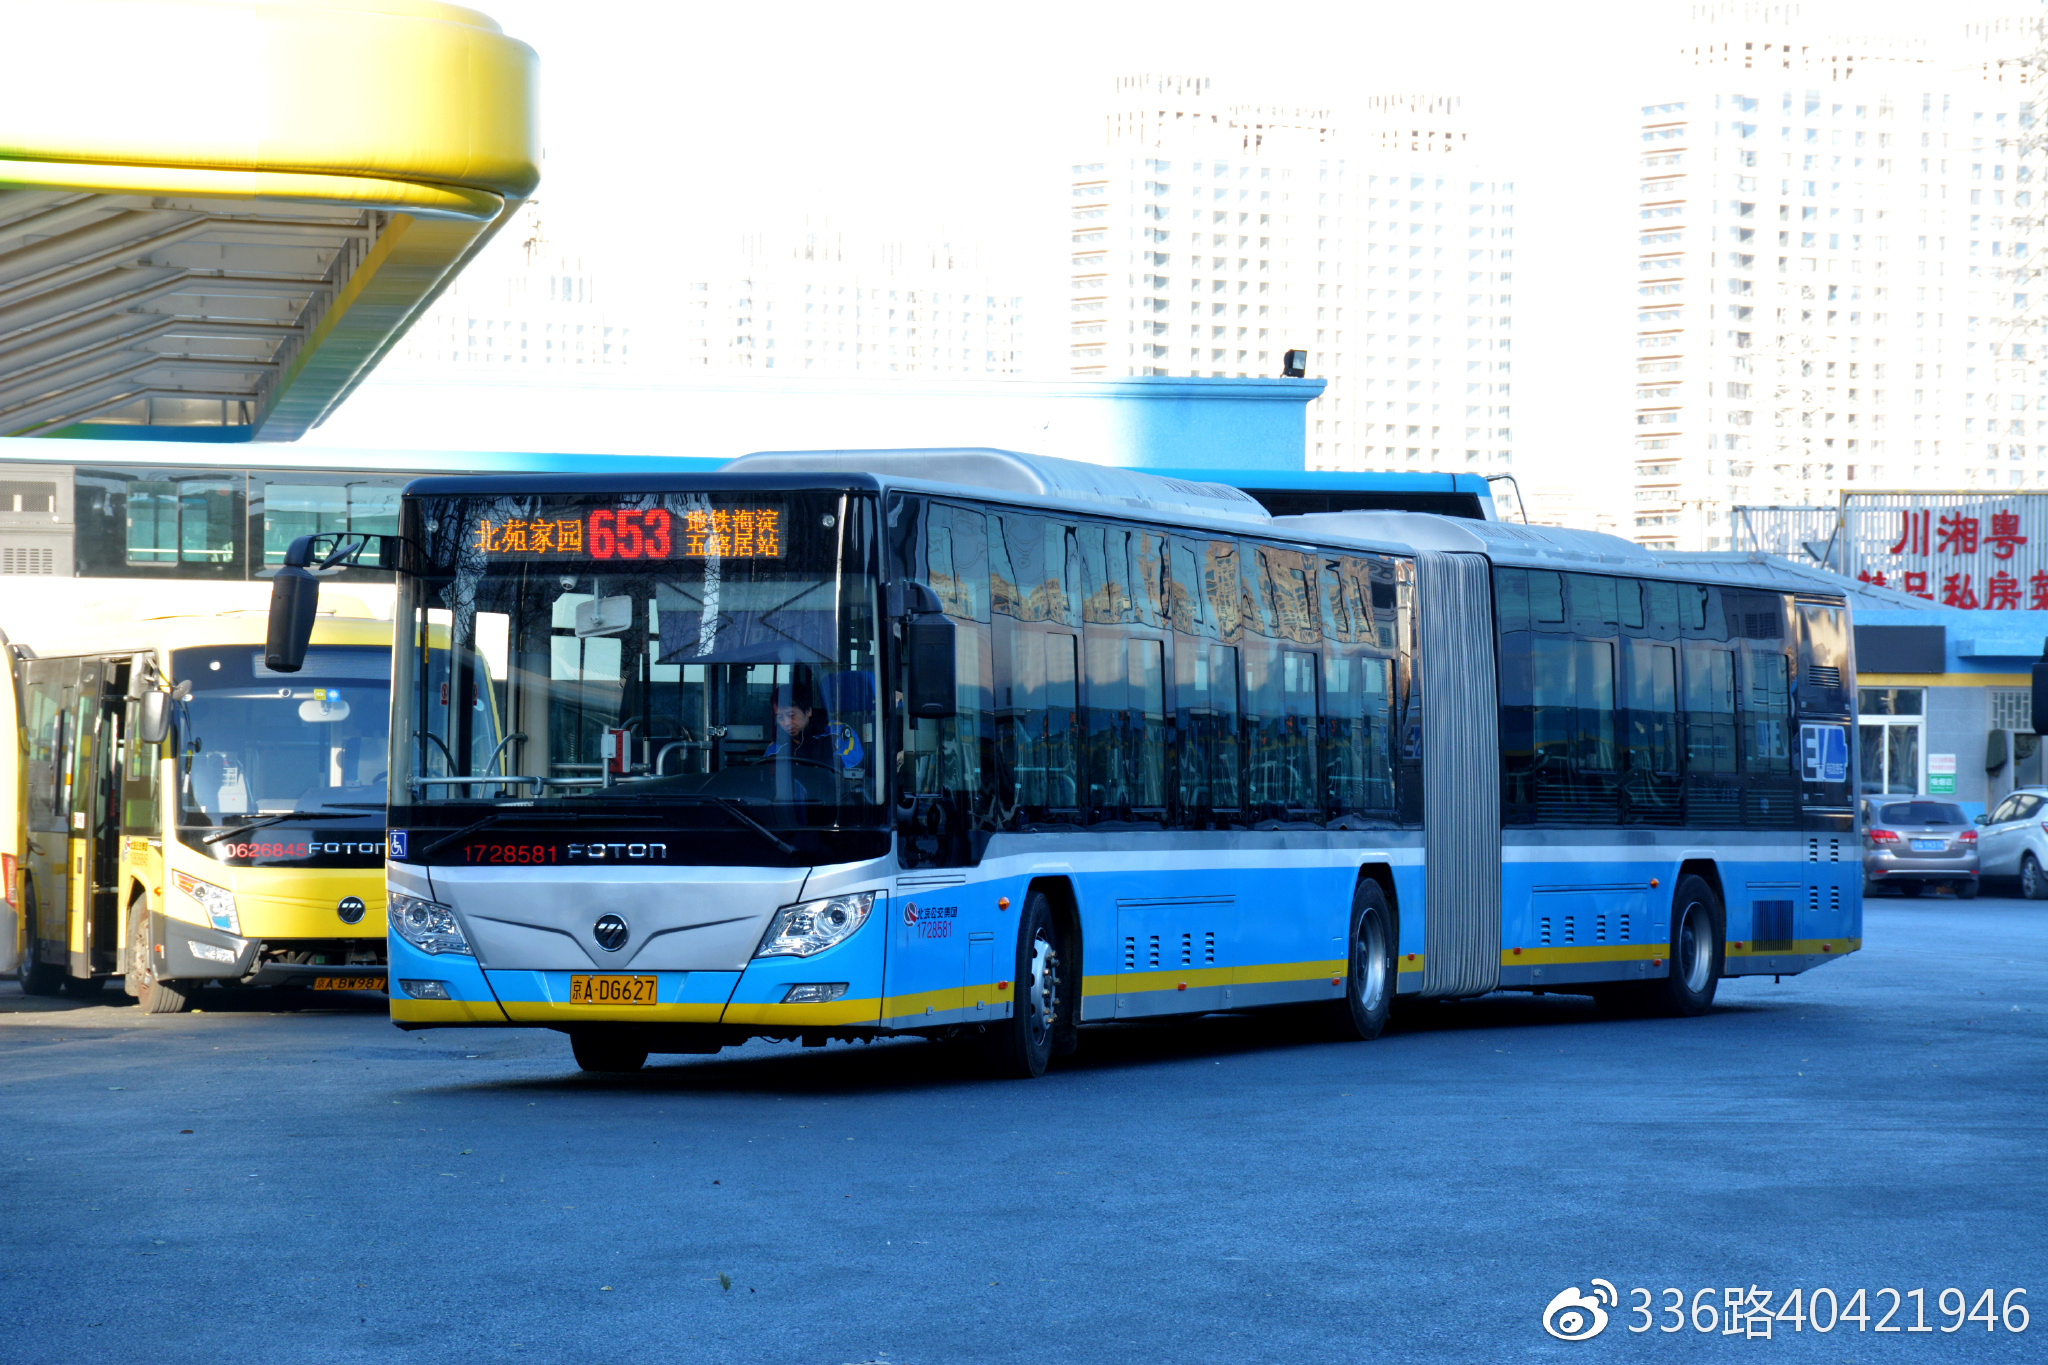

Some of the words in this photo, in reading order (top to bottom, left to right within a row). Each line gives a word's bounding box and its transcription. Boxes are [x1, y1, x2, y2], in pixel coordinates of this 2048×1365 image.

[685, 509, 779, 533] 地铁海淀
[473, 518, 582, 553] 北苑家园
[588, 508, 671, 559] 653
[685, 533, 779, 557] 五路居站
[1890, 509, 2027, 560] 川湘粤
[463, 844, 556, 863] 1728581
[567, 843, 667, 859] FOTON
[917, 906, 958, 920] 北京公交集团
[917, 920, 952, 939] 1728581
